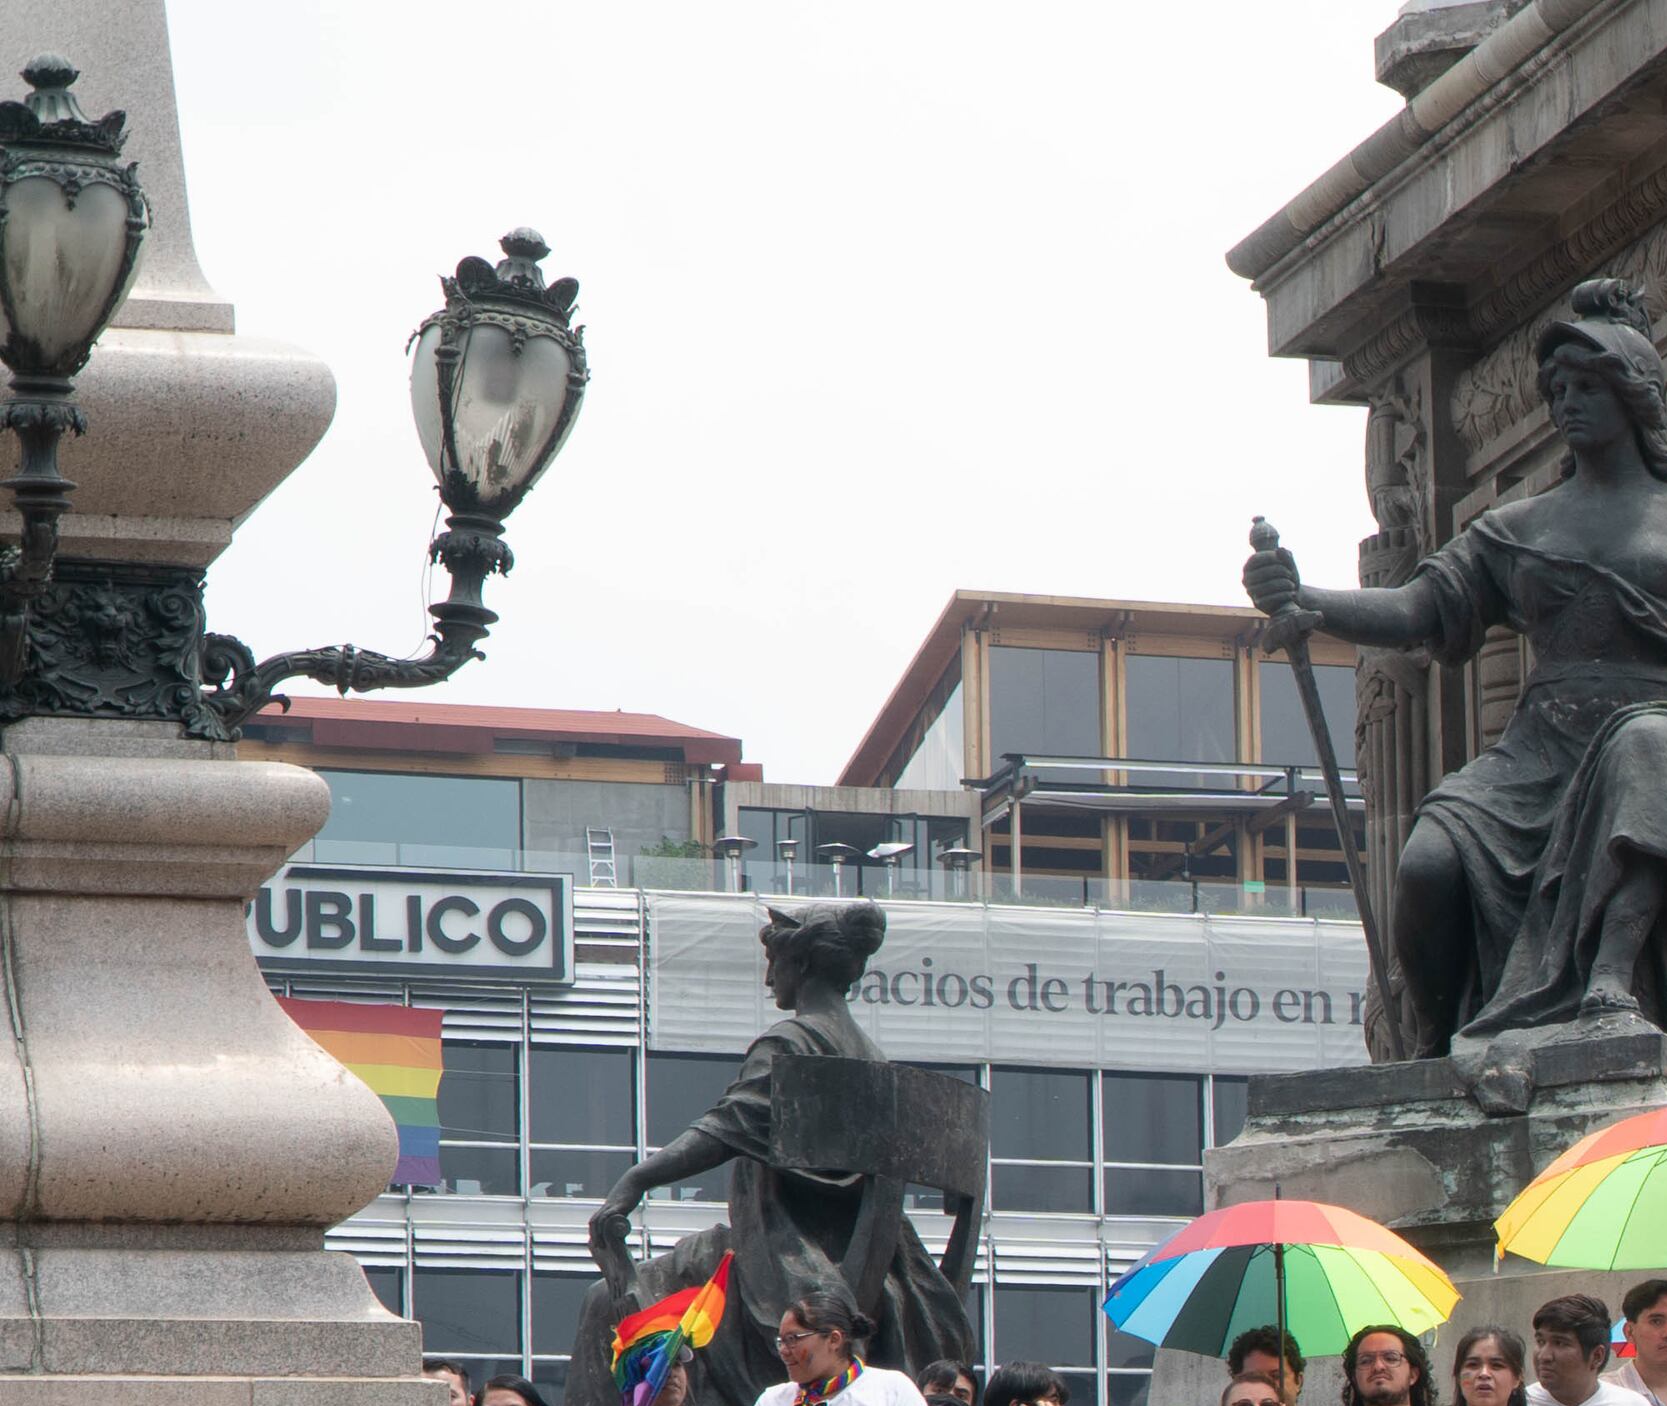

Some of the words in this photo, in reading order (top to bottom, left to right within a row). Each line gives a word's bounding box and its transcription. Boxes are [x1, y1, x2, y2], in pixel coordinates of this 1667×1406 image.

[1007, 963, 1069, 1013] de
[1082, 969, 1261, 1031] trabajo
[1272, 989, 1335, 1025] en
